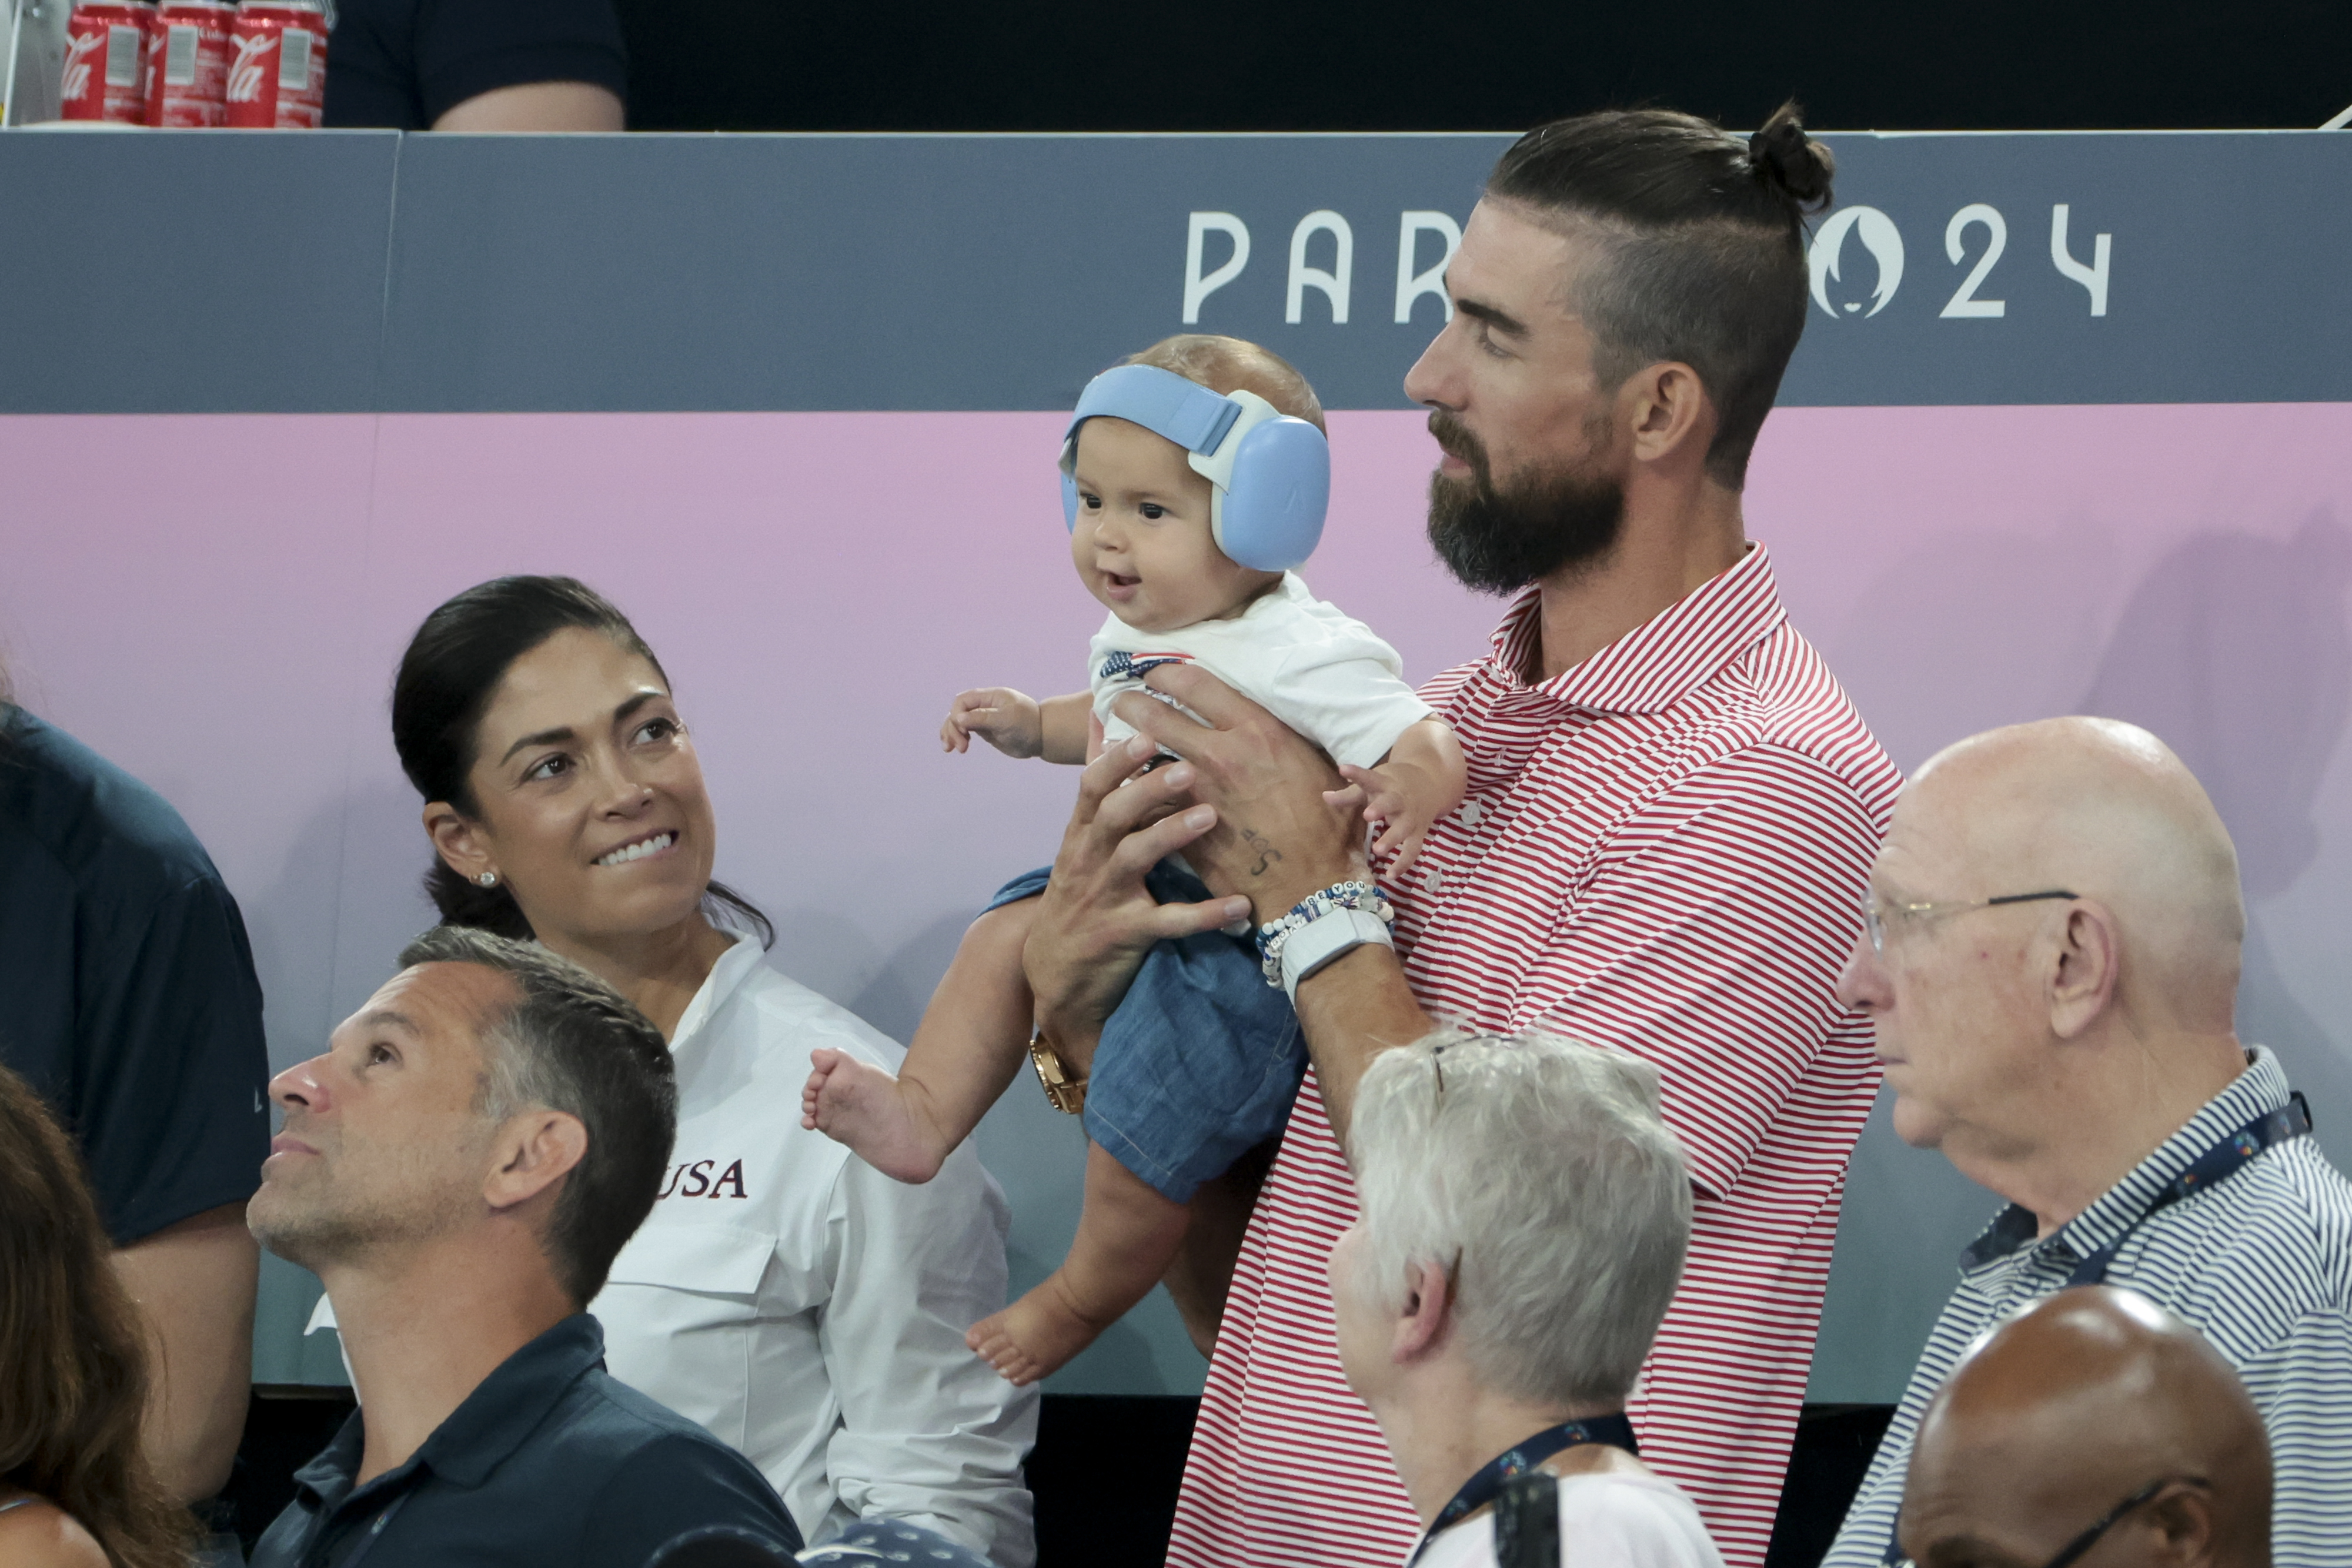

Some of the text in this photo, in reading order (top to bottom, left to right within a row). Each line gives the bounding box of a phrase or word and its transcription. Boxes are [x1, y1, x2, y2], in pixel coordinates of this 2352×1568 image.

[1181, 209, 1462, 325] PAR
[1307, 881, 1365, 906] BE YOU
